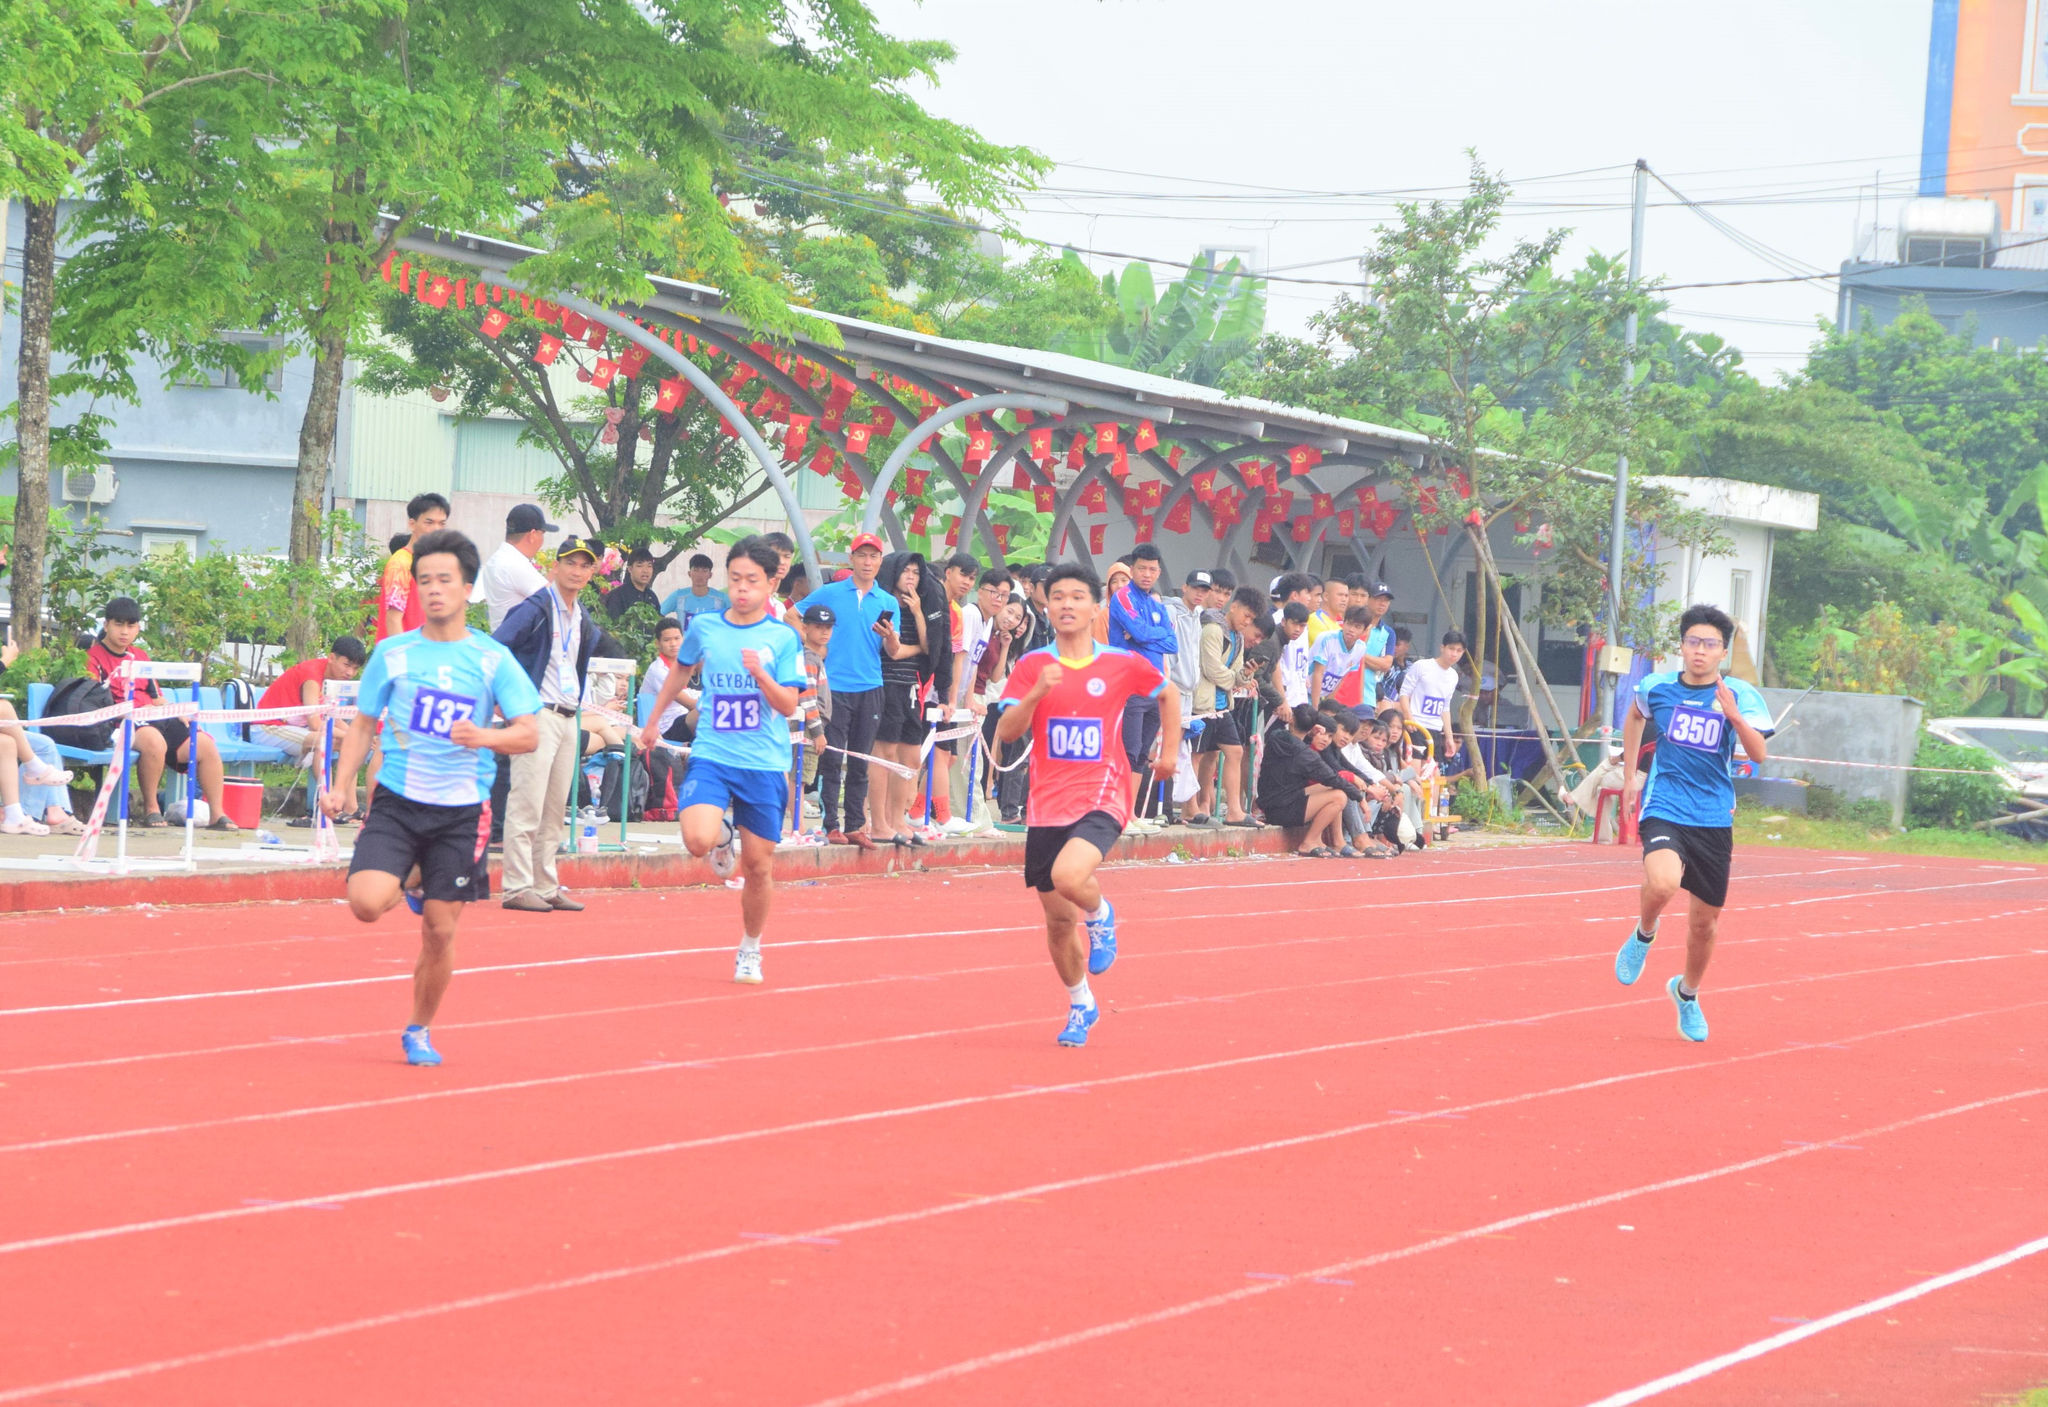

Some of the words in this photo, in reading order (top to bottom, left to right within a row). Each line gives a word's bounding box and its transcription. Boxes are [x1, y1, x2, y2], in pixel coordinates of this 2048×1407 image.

[437, 665, 453, 690] 5
[419, 694, 473, 734] 137
[716, 700, 759, 728] 213
[1423, 698, 1444, 716] 216
[1051, 724, 1100, 757] 049
[1673, 713, 1720, 746] 350
